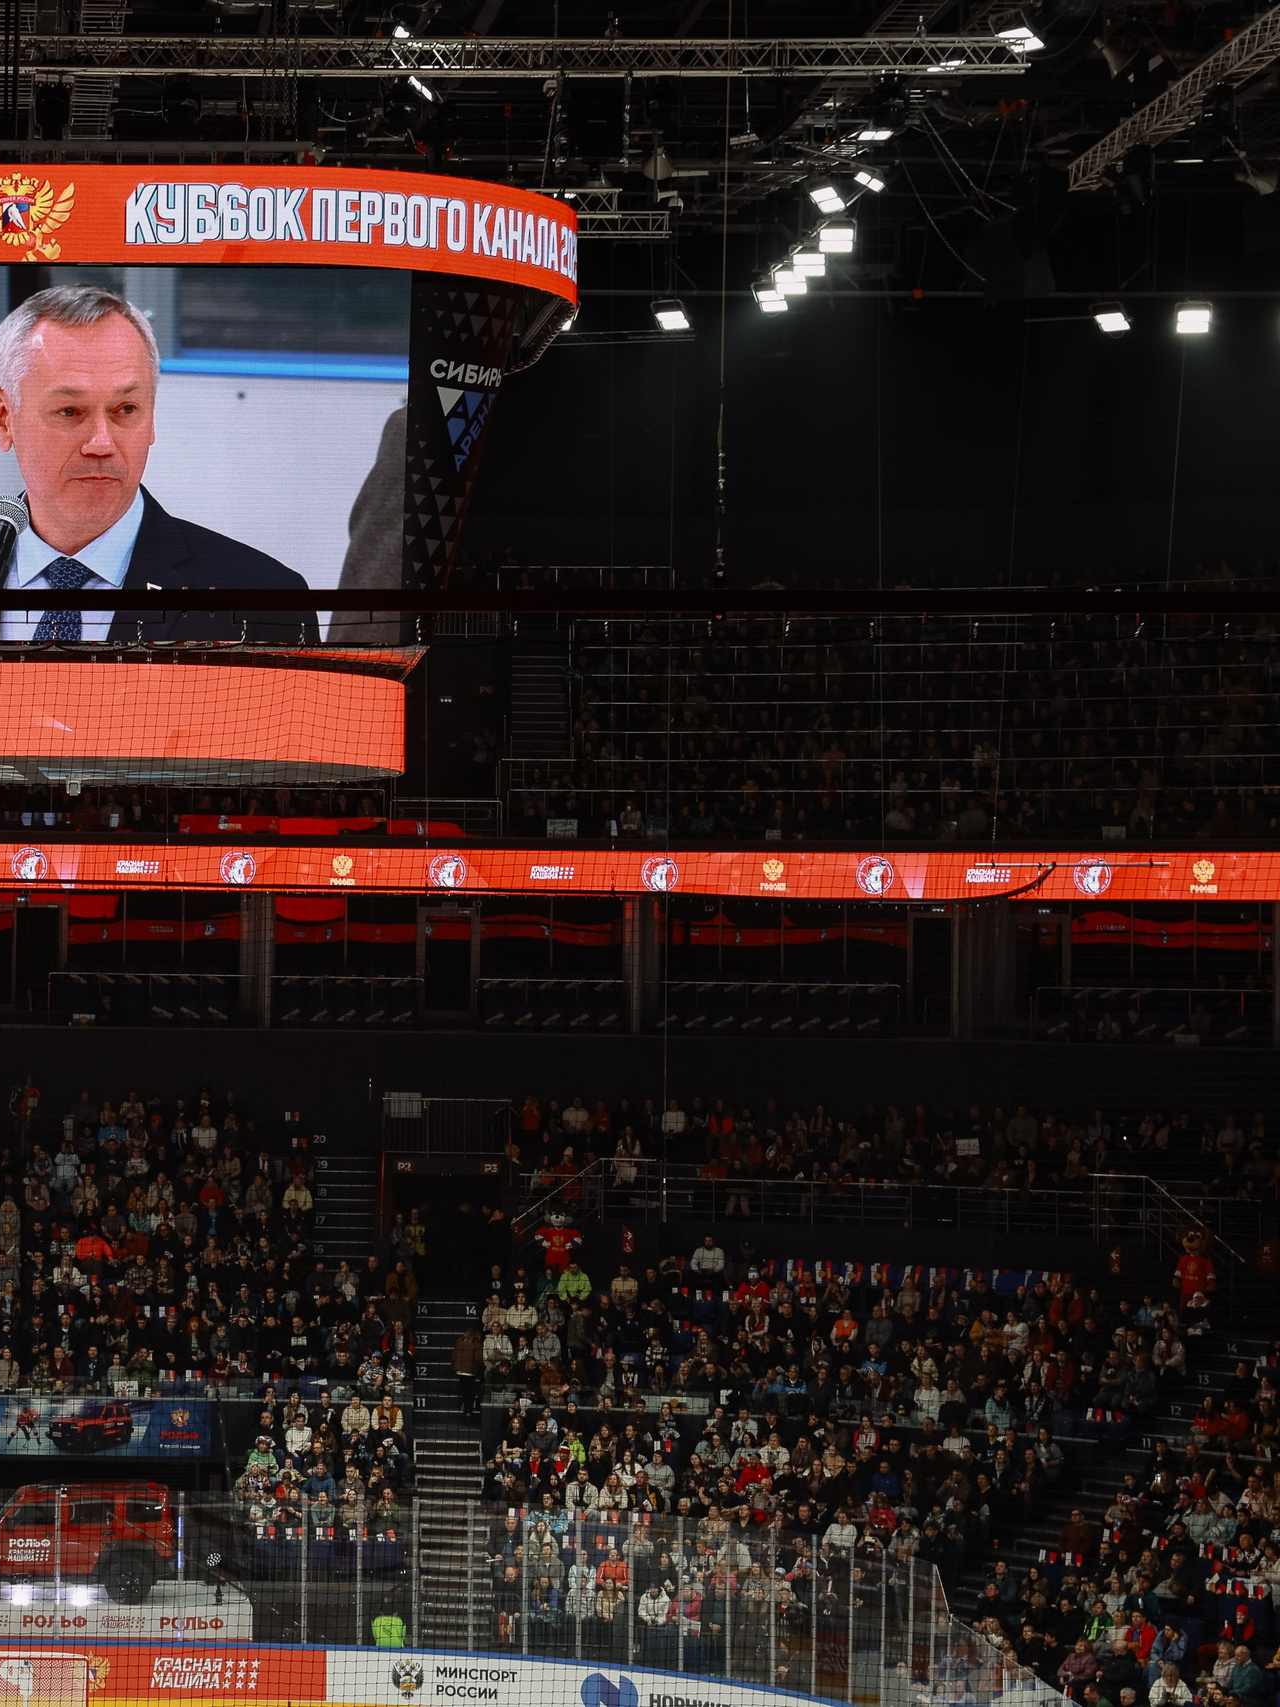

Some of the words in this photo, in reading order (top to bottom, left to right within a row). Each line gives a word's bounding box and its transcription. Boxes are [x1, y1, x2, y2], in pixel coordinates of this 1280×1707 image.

[311, 188, 467, 252] ПЕРВОГО
[472, 201, 559, 273] КАНАЛА
[560, 224, 578, 285] 202
[429, 358, 502, 388] СИБИРЬ
[397, 1161, 412, 1171] P2
[483, 1163, 499, 1173] P3
[417, 1305, 429, 1315] 14
[465, 1305, 477, 1316] 14
[417, 1335, 429, 1345] 13
[415, 1366, 428, 1376] 12
[415, 1397, 426, 1408] 11
[160, 1431, 200, 1440] РОЛЬФ
[9, 1538, 51, 1548] РОЛЬФ
[22, 1614, 87, 1629] РОЛЬФ
[160, 1616, 224, 1630] РОЛЬФ
[153, 1656, 223, 1674] КРАСНАЯ
[436, 1665, 518, 1684] МИНСПОРТ
[150, 1671, 222, 1690] МАШИНА
[436, 1683, 499, 1701] РОССИИ
